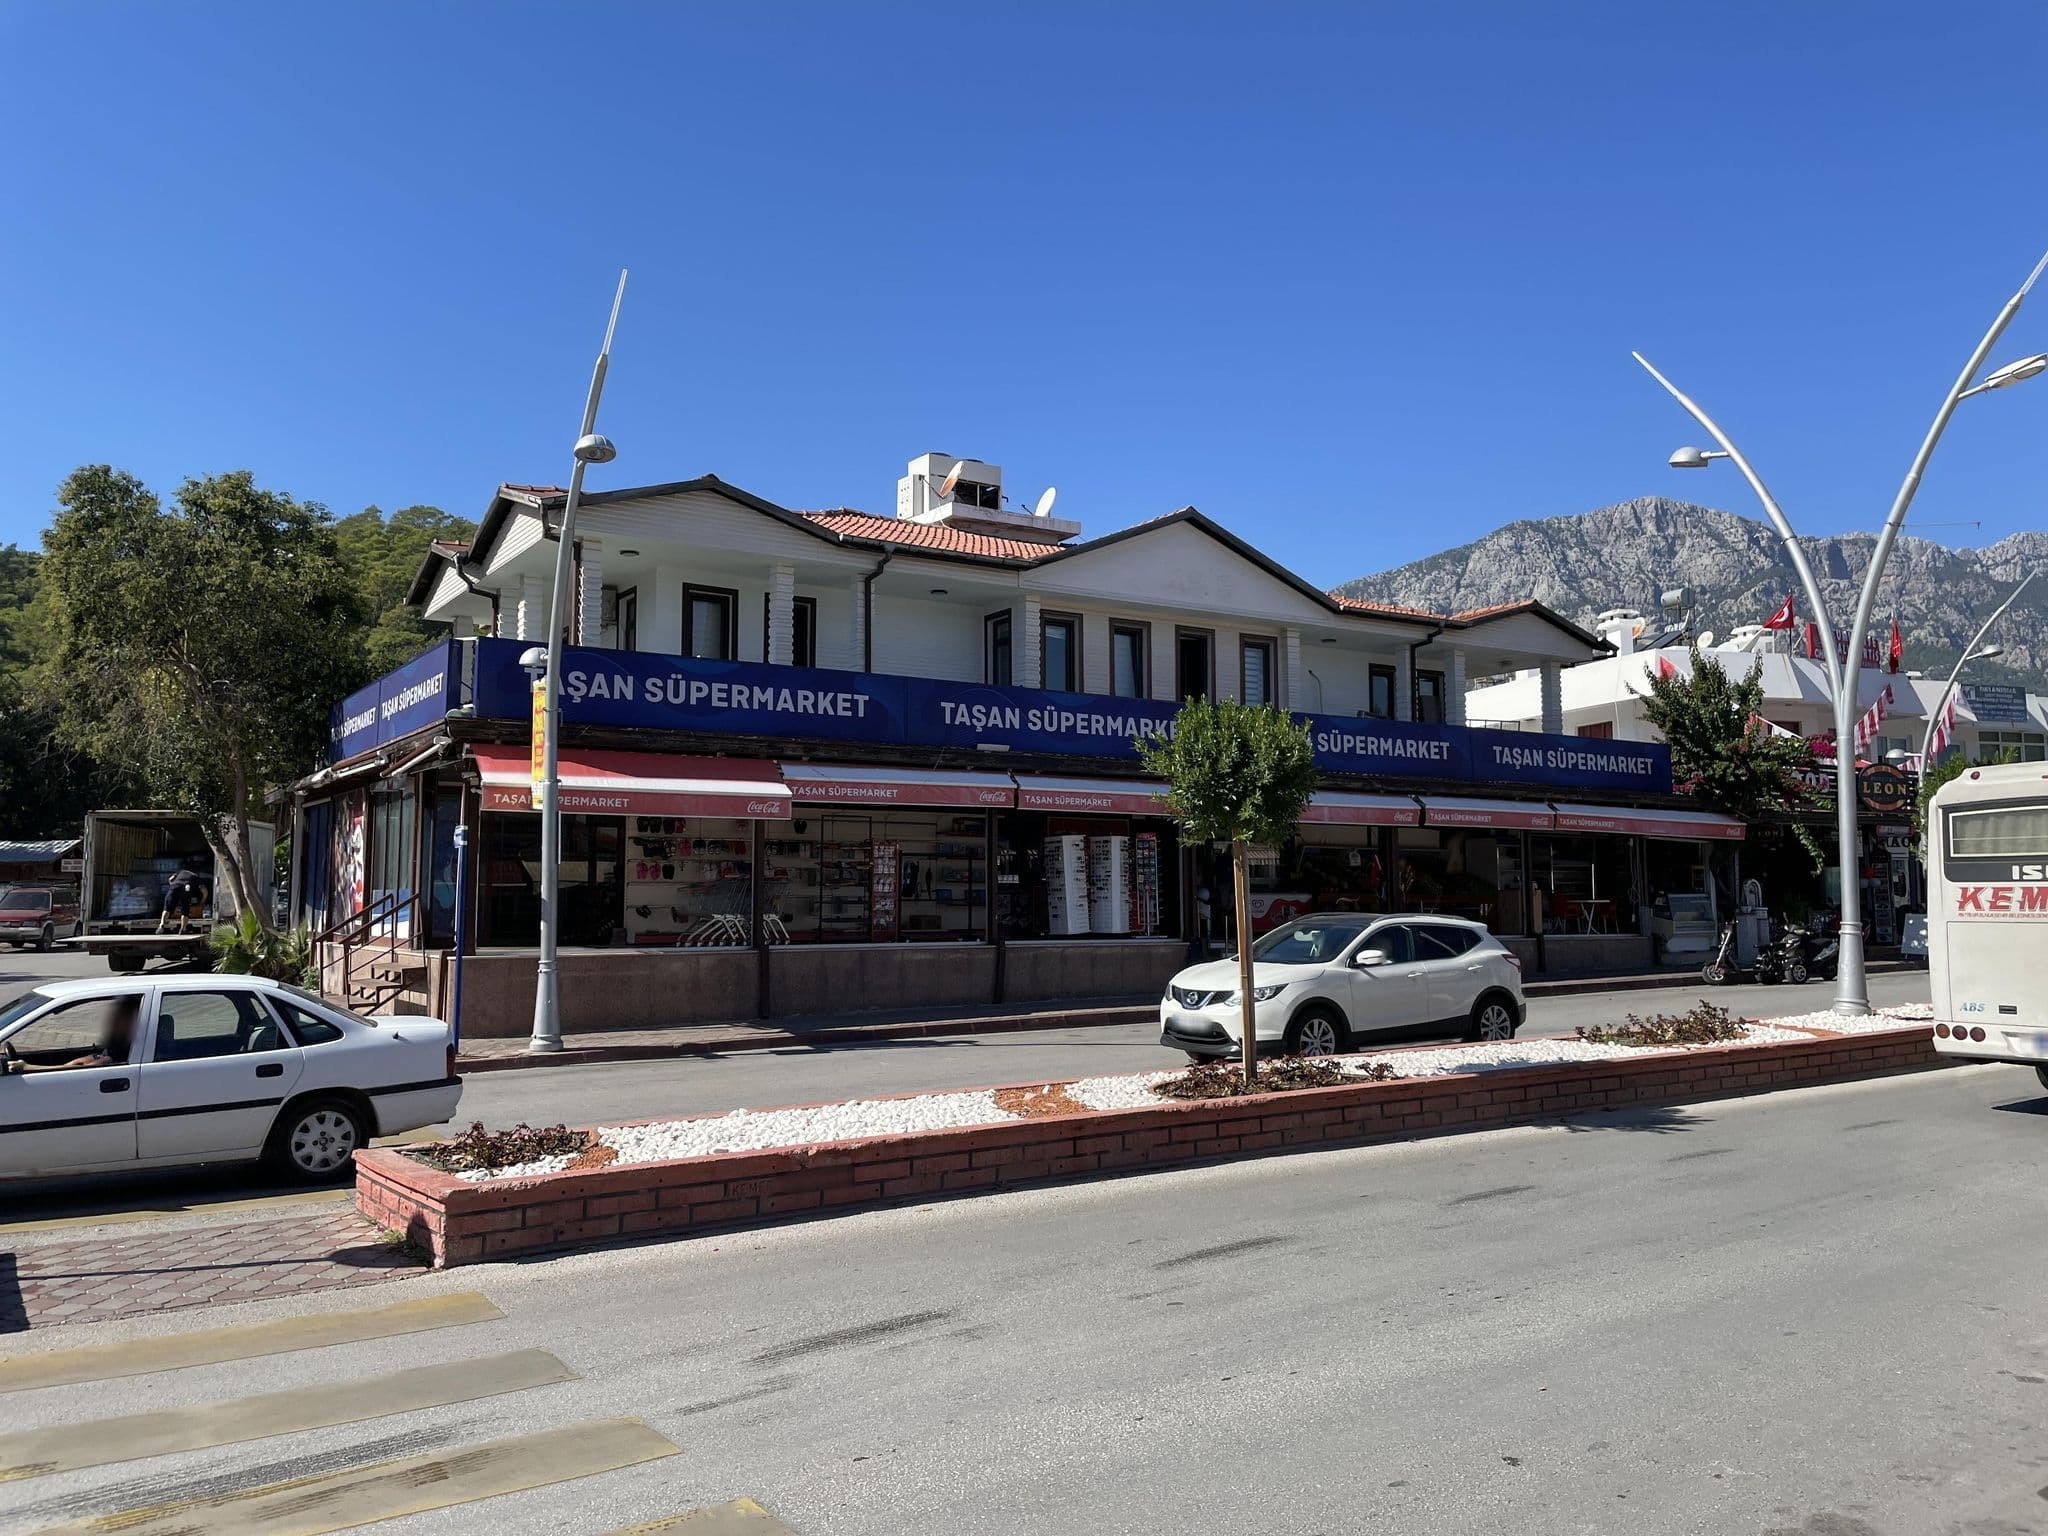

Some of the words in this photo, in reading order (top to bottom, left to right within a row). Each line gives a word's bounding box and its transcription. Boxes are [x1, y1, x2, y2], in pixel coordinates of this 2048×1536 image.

[381, 694, 400, 720] TAŞAN
[399, 672, 444, 712] SÜPERMARKET
[523, 666, 634, 704] TŞAN
[644, 674, 870, 719] SÜPERMARKET
[940, 701, 1020, 733] TAŞAN
[1317, 729, 1451, 761] SÜPERMARKET
[1492, 745, 1544, 770] TAŞAN
[1547, 747, 1654, 776] SÜPERMARKET
[792, 786, 826, 797] TAŞAN
[828, 786, 898, 799] SÜPERMARKET
[1862, 781, 1907, 796] LEON
[1025, 794, 1054, 807] TAŞAN
[1054, 795, 1113, 808] SÜPERMARKET
[1451, 812, 1492, 824] SÜPERMARKET
[2012, 864, 2048, 881] IS
[1960, 1002, 1986, 1013] ABS
